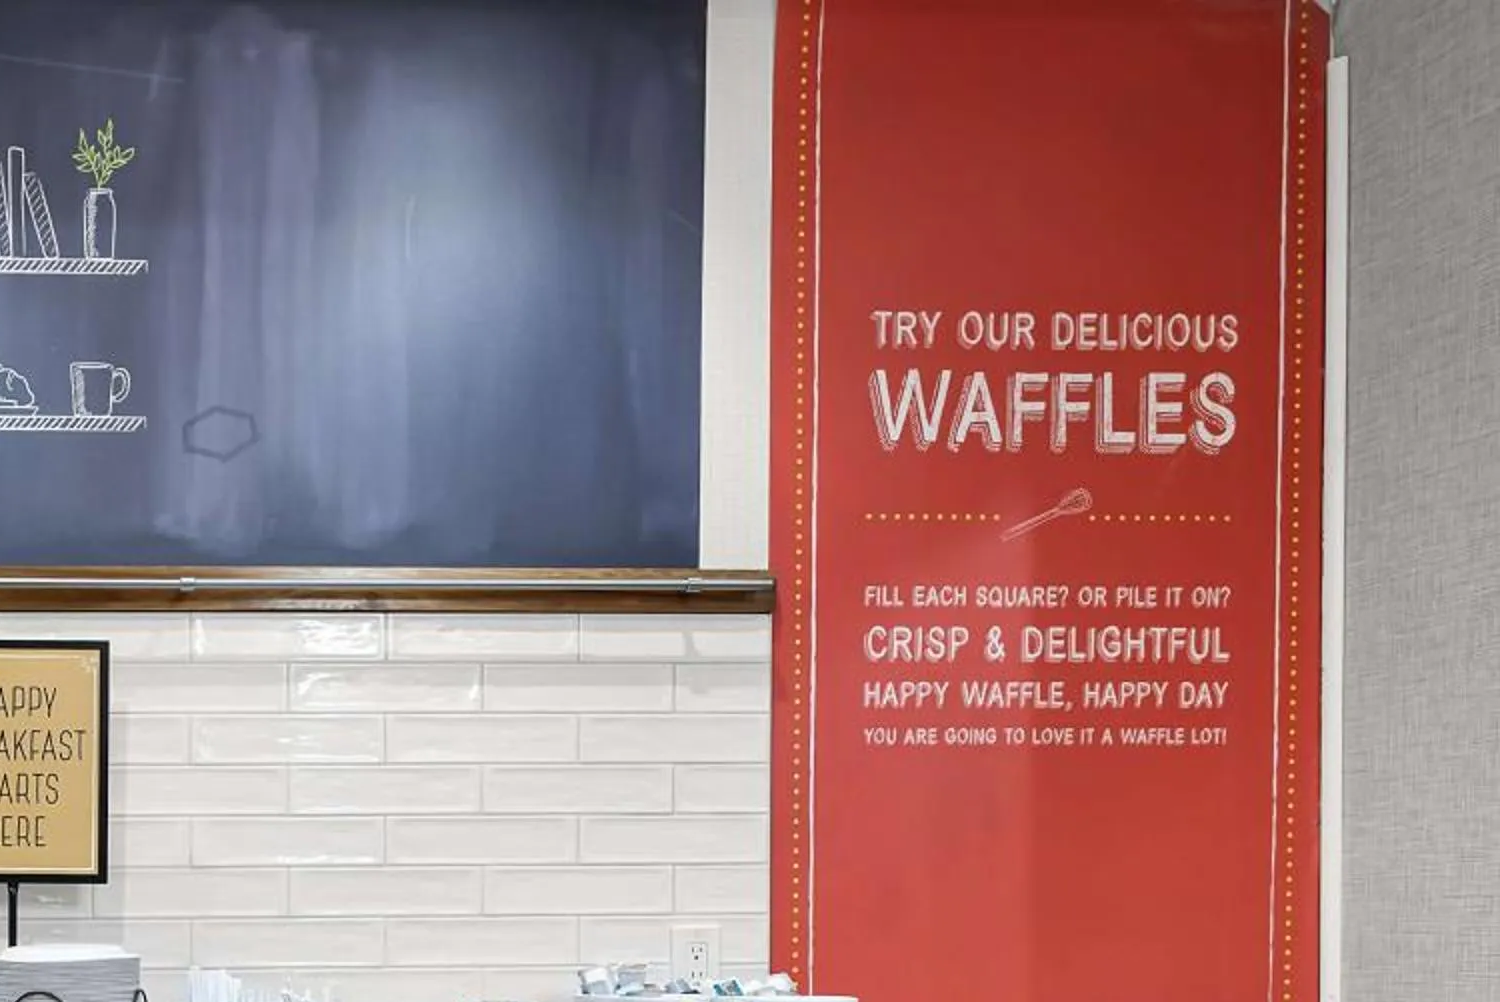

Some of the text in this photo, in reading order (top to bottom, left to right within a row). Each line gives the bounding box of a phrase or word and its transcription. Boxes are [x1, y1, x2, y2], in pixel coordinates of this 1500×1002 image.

[870, 309, 1240, 353] TRY OUR DELICIOUS
[867, 366, 1238, 456] WAFFLES
[863, 584, 1232, 609] FILL EACH SQUARE? OR PILE IT ON?
[863, 624, 1231, 665] CRISP & DELIGHTFUL
[863, 680, 1230, 712] HAPPY WAFFLE, HAPPY DAY
[863, 726, 1228, 747] YOU ARE GOING TO LOVE IT A WAFFLE LOT!
